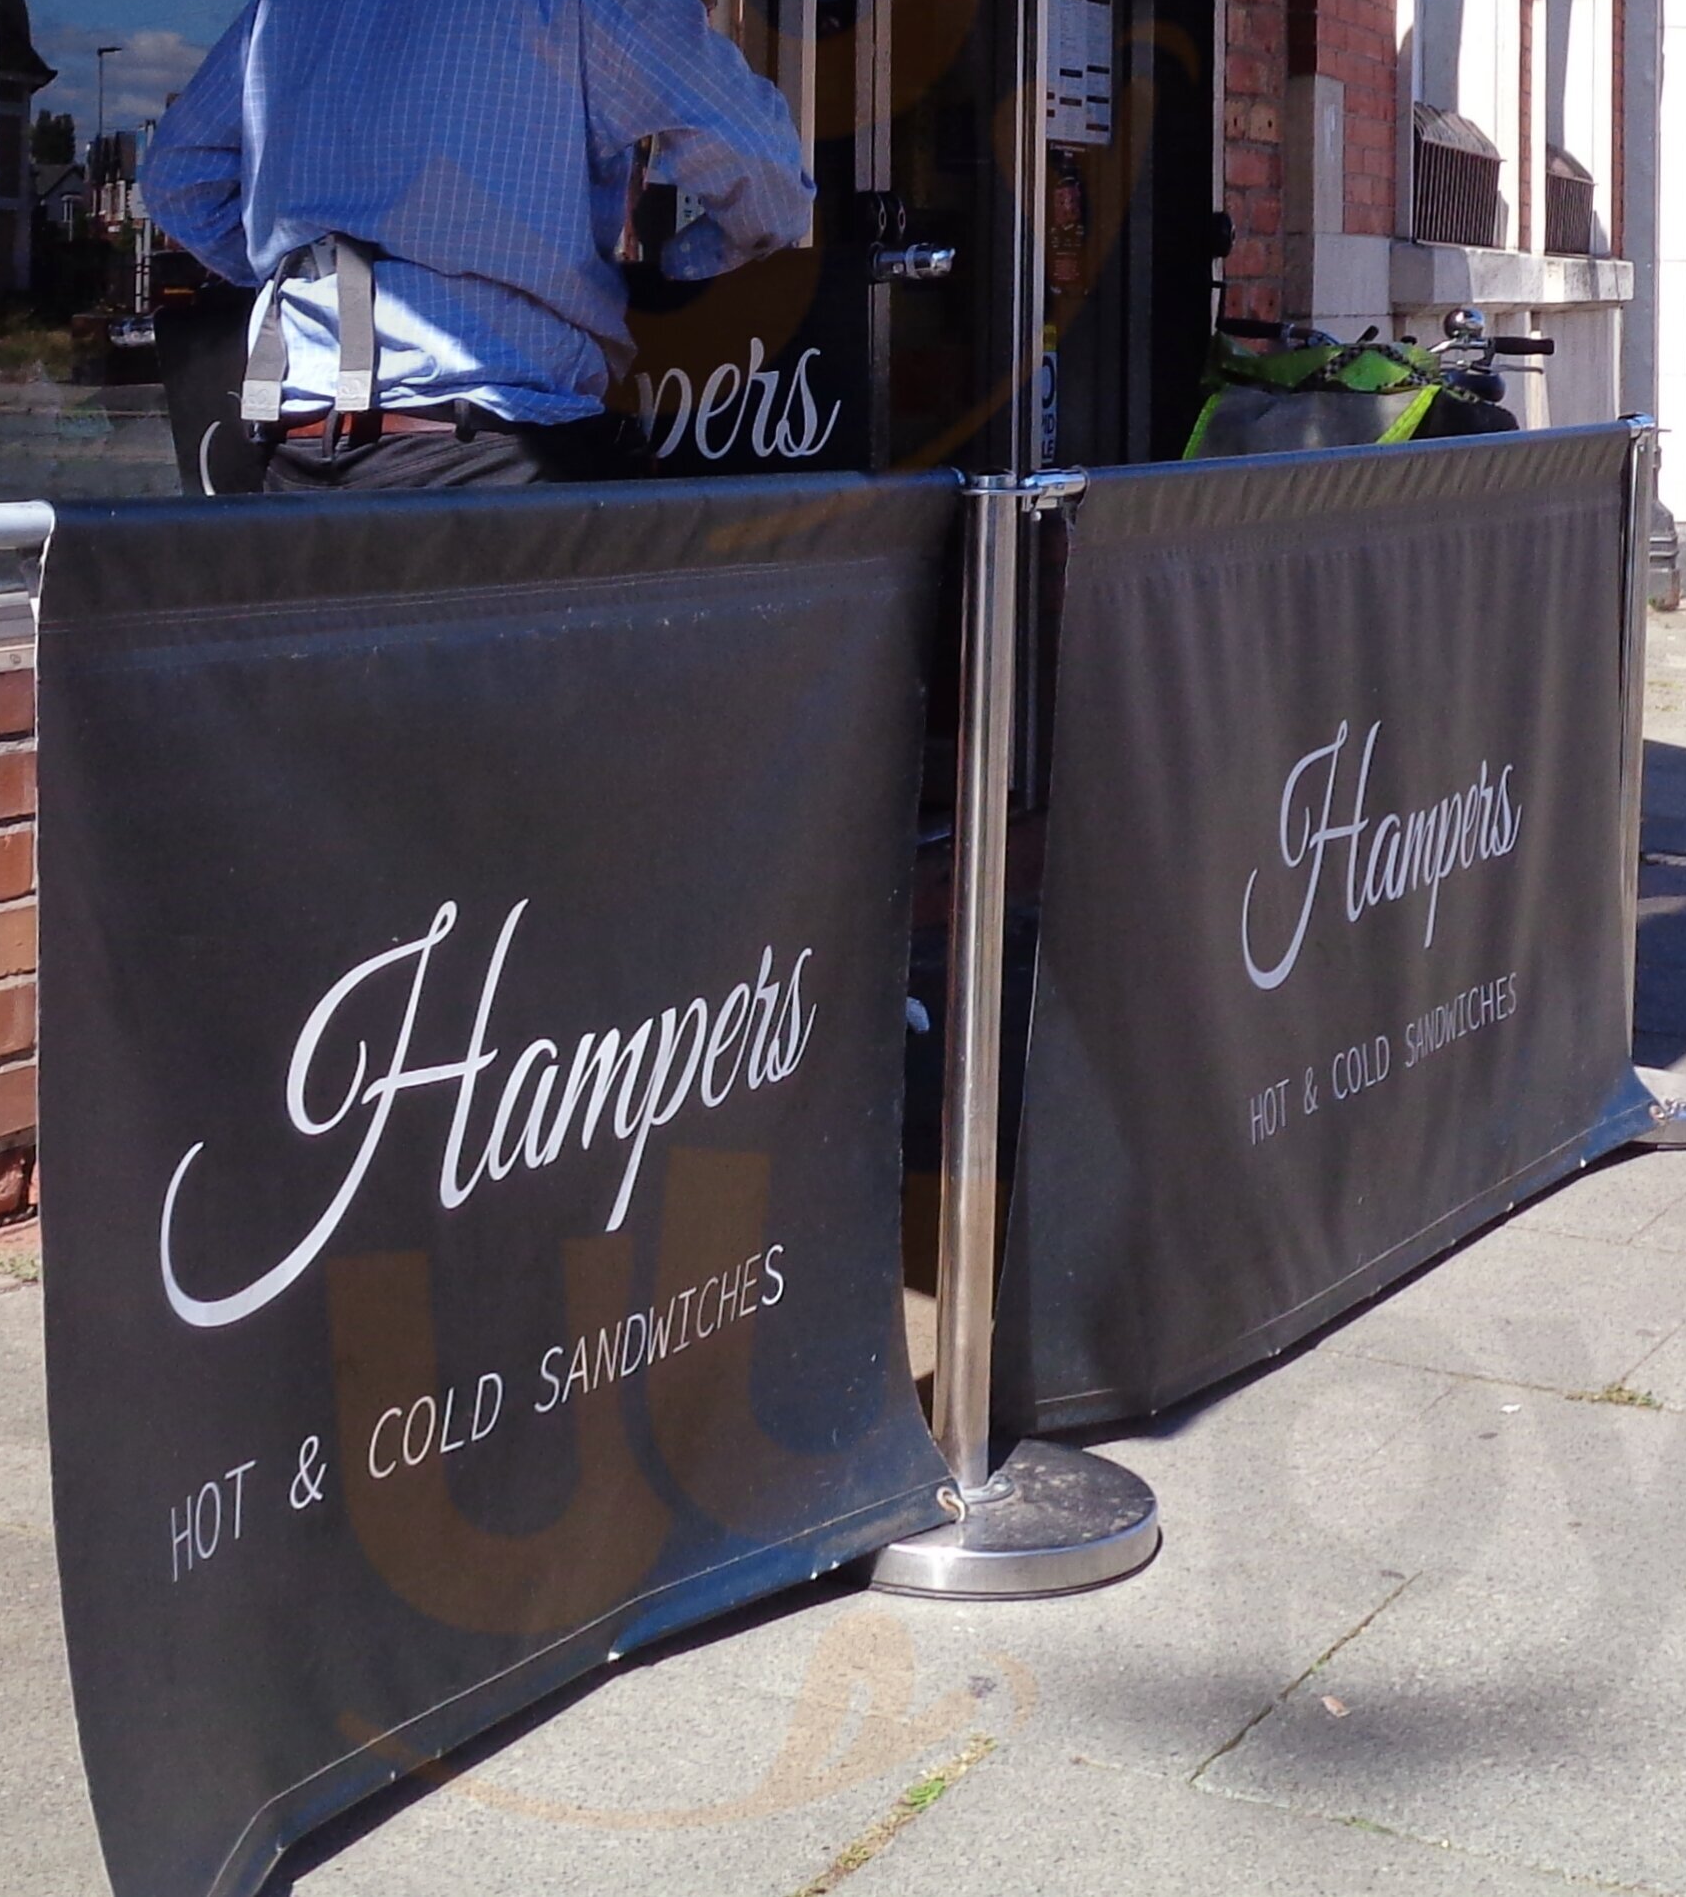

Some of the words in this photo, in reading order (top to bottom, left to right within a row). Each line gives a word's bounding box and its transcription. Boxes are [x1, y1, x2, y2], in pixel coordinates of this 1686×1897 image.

[1242, 719, 1521, 990] Hampers
[161, 898, 817, 1327] Hampers
[1250, 1078, 1290, 1145] HOT
[1303, 1066, 1319, 1116] &
[1332, 1035, 1390, 1100] COLD
[1405, 972, 1517, 1069] SANDWICHES
[169, 1460, 257, 1582] HOT
[289, 1435, 328, 1510] &
[368, 1371, 504, 1479] COLD
[534, 1243, 786, 1414] SANDWICHES
